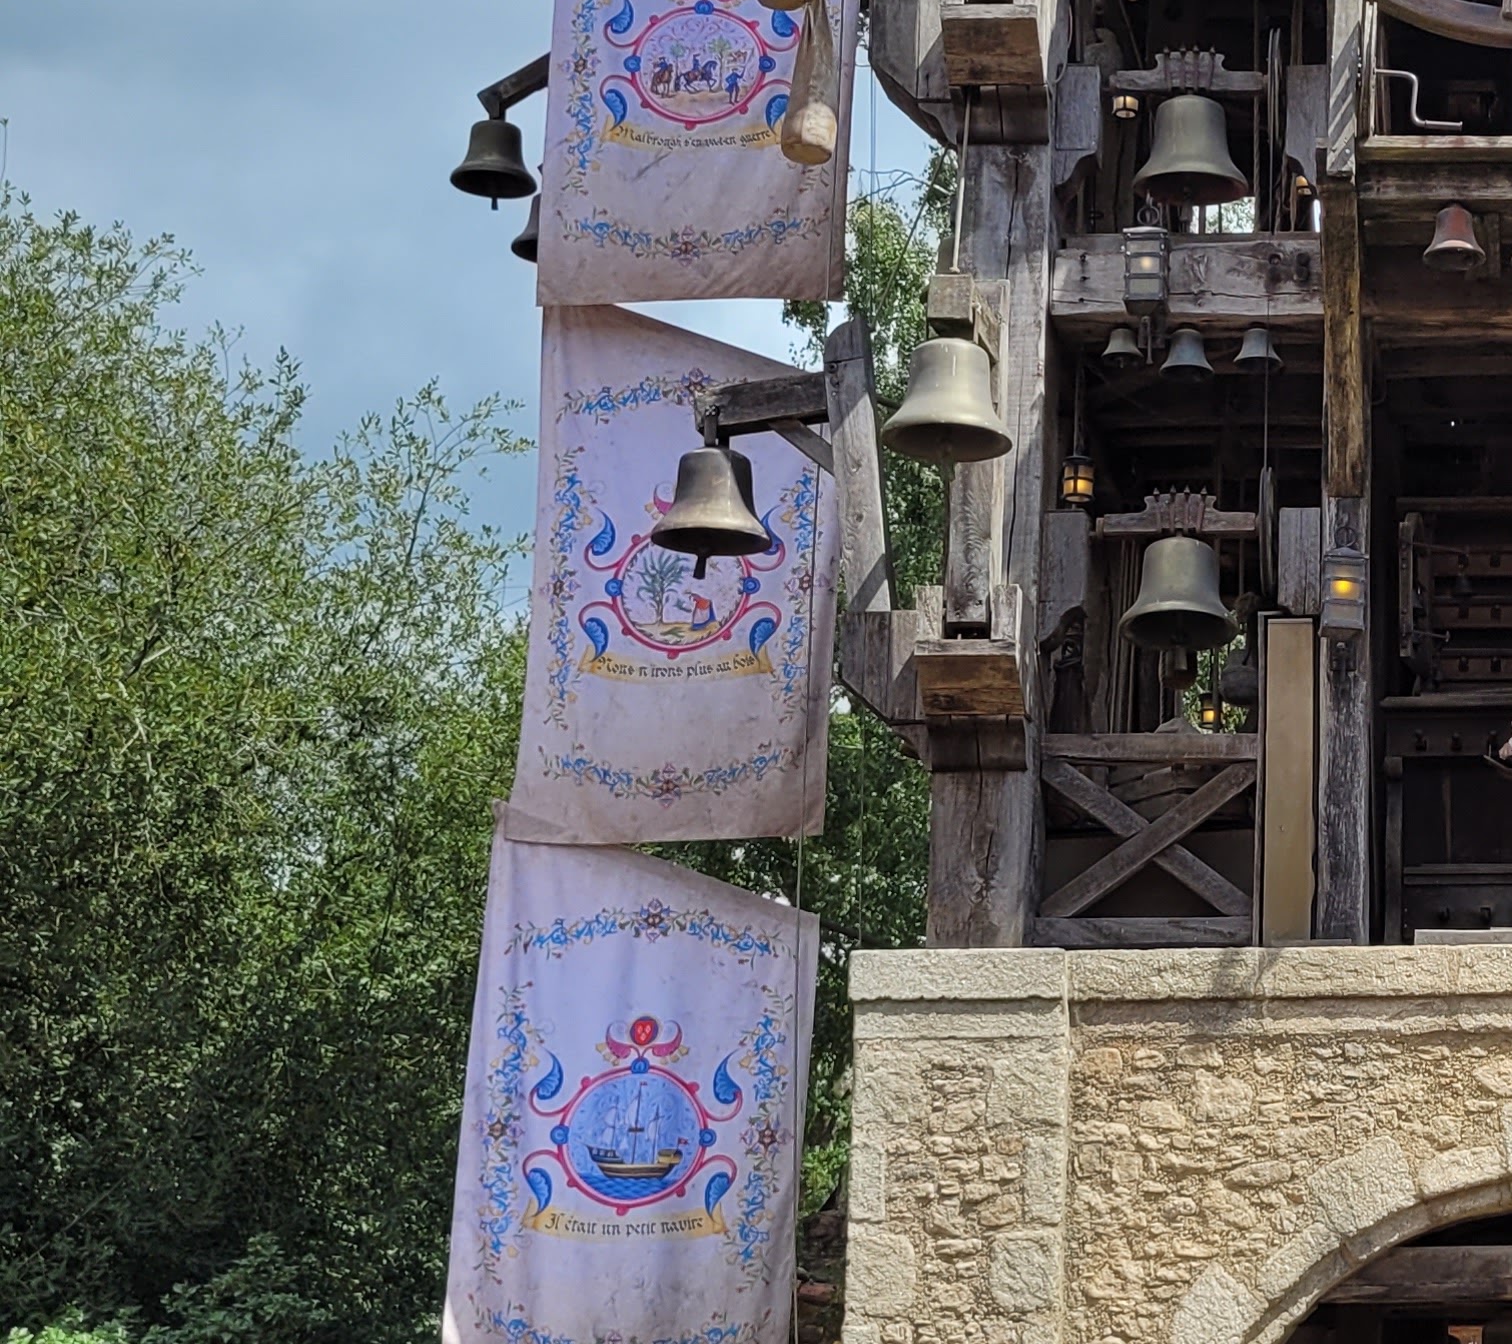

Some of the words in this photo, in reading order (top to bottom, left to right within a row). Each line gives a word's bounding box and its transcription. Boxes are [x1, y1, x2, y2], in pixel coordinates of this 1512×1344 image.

[740, 130, 771, 147] guerre
[597, 656, 635, 675] Nous
[687, 661, 714, 680] plus
[716, 662, 732, 673] au
[733, 654, 758, 670] bois
[545, 1213, 564, 1231] Il
[565, 1216, 598, 1235] était
[601, 1223, 621, 1236] un
[625, 1222, 657, 1237] petit
[661, 1218, 704, 1234] navire
